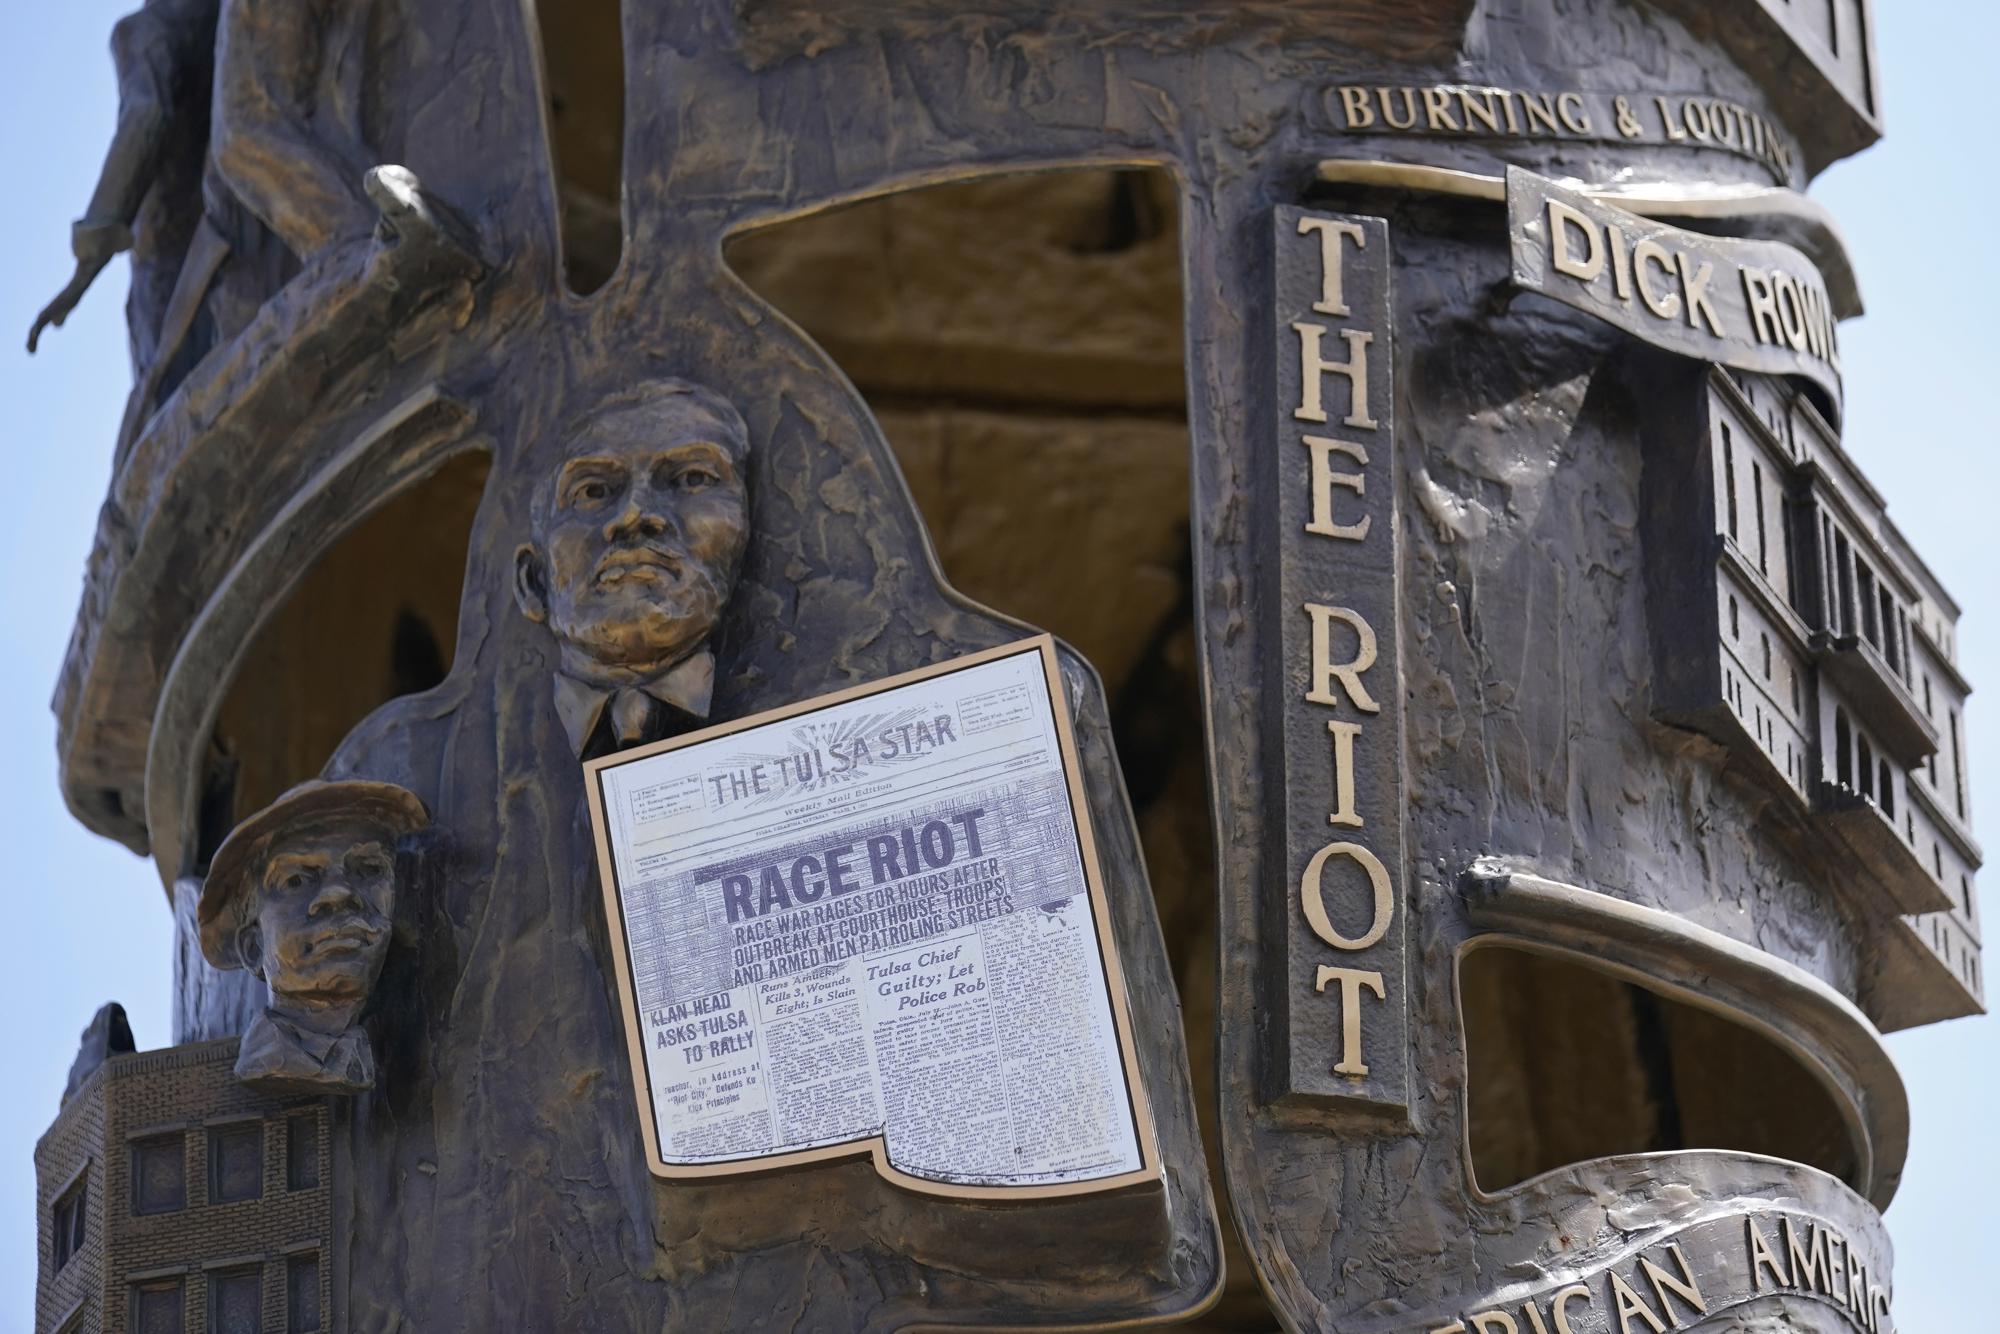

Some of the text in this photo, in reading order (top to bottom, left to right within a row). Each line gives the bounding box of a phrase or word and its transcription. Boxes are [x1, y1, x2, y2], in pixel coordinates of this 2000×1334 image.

[1339, 85, 1592, 135] BURNING
[1615, 95, 1643, 138] &
[1546, 198, 1724, 339] DICK
[1294, 216, 1377, 542] THE
[708, 764, 770, 805] THE
[773, 736, 874, 787] TULSA
[878, 713, 957, 761] STAR
[784, 800, 823, 817] Weekly
[827, 792, 851, 805] Mail
[855, 783, 893, 798] Edition
[1301, 603, 1394, 1077] RIOT
[721, 846, 860, 924] RACE
[866, 807, 985, 885] RIOT
[735, 857, 1000, 946] RACE WAR RAGES FOR HOURS AFTER
[734, 929, 813, 967] OUTBREAK
[817, 924, 838, 946] AT
[943, 877, 1004, 910] TROOPS
[734, 894, 1014, 988] AND ARMED MEN PATROLING STREETS
[761, 967, 836, 994] Runs Amuck,
[866, 945, 962, 981] Tulsa Chief
[878, 963, 975, 996] Guilty; Let
[765, 975, 851, 1005] Kills 3, Wounds
[776, 988, 856, 1015] Eight; Is Slain
[898, 977, 986, 1011] Police Rob
[650, 992, 731, 1028] KLAN HEAD
[657, 1010, 749, 1049] ASKS TULSA
[683, 1030, 755, 1064] TO RALLY
[711, 1065, 747, 1082] Address
[751, 1061, 761, 1071] at
[716, 1080, 743, 1094] Defends
[746, 1076, 756, 1086] Ku
[706, 1093, 740, 1109] Principles
